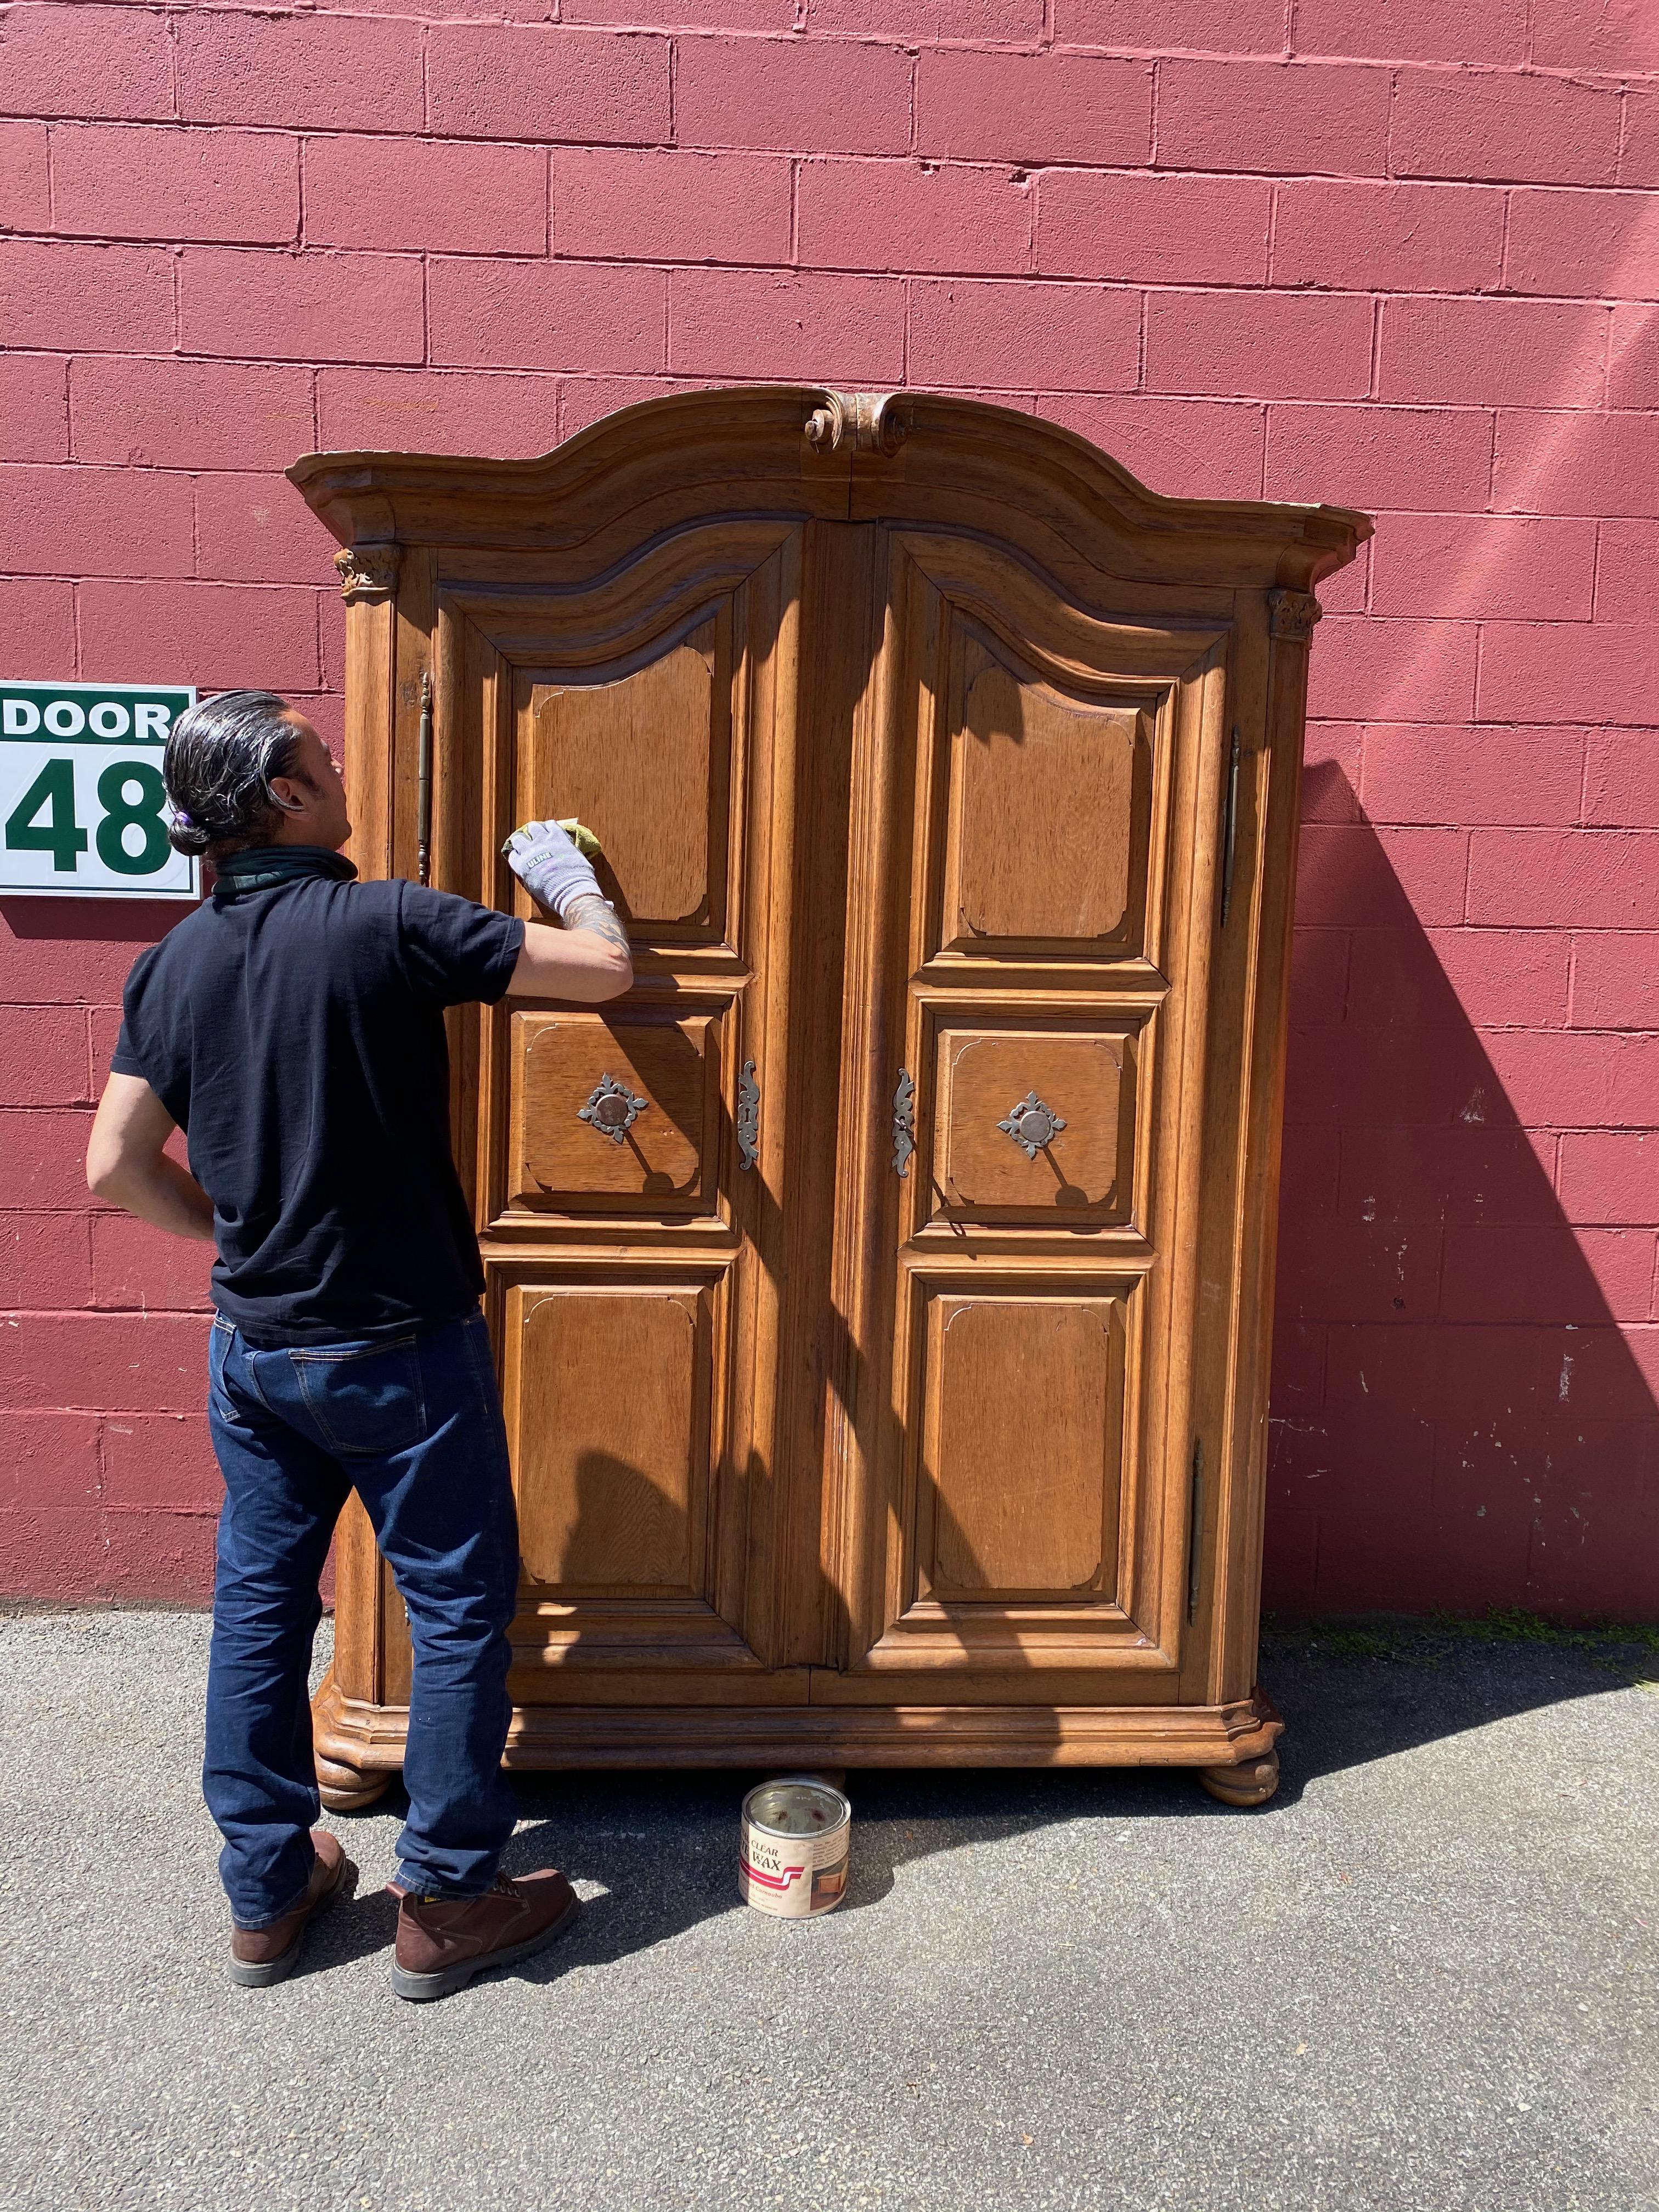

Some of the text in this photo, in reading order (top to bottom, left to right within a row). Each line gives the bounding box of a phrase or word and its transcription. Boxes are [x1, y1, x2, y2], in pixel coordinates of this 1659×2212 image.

[3, 699, 171, 738] DOOR
[5, 759, 172, 875] 48
[528, 851, 552, 868] ULINE
[752, 1840, 778, 1857] CLEAR
[753, 1851, 781, 1871] WAX
